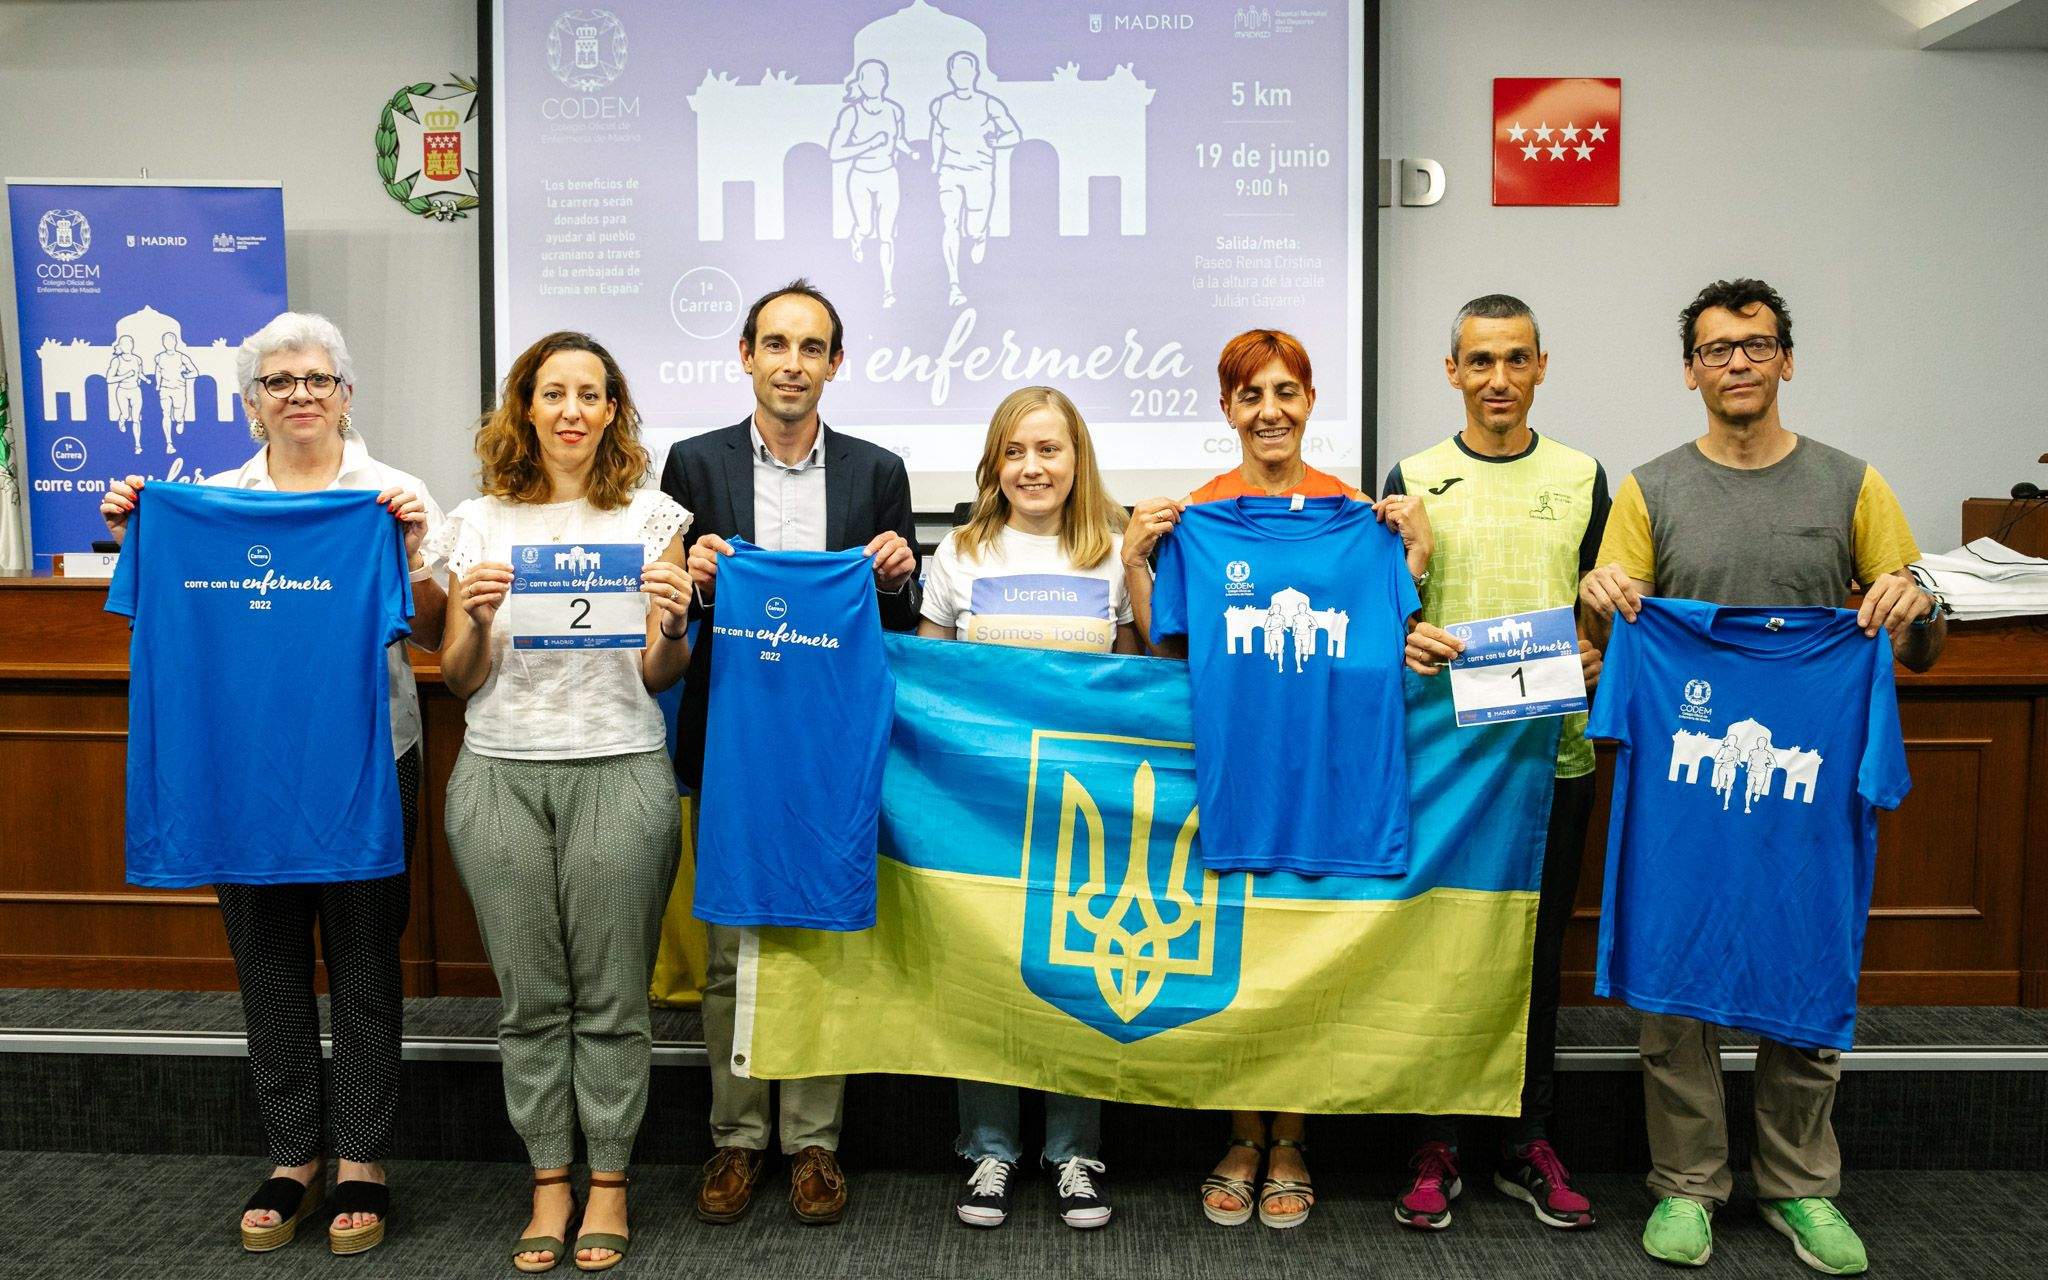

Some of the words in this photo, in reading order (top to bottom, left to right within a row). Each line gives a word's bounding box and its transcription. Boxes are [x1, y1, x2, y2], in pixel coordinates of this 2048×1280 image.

[1115, 15, 1194, 30] MADRID
[1232, 82, 1245, 106] 5
[1255, 81, 1292, 106] km
[542, 97, 640, 119] CODEM
[1195, 143, 1222, 167] 19
[1232, 142, 1260, 167] de
[1268, 143, 1330, 173] junio
[568, 178, 622, 190] beneficios
[626, 178, 640, 189] de
[1235, 179, 1272, 196] 9:00
[1278, 178, 1288, 196] h
[547, 197, 558, 208] la
[560, 199, 599, 208] carrera
[554, 213, 600, 225] donados
[602, 215, 627, 227] para
[141, 236, 187, 246] MADRID
[544, 231, 583, 245] ayudar
[586, 231, 596, 242] al
[600, 230, 636, 244] pueblo
[541, 249, 594, 260] ucraniano
[597, 250, 604, 259] a
[607, 247, 641, 260] través
[1195, 255, 1232, 269] Paseo
[1274, 254, 1322, 268] Cristina
[36, 264, 100, 278] CODEM
[542, 266, 555, 277] de
[559, 266, 568, 277] la
[571, 265, 624, 279] embajada
[627, 265, 640, 276] de
[1262, 274, 1277, 287] de
[1295, 274, 1325, 287] calle
[540, 284, 581, 295] Ucrania
[583, 285, 597, 294] en
[680, 298, 733, 312] Carrera
[660, 359, 740, 384] corre
[865, 308, 1194, 406] enfermera
[1130, 388, 1198, 417] 2022
[55, 451, 82, 459] Carrera
[35, 479, 72, 492] corre
[77, 479, 105, 492] con
[184, 580, 208, 588] corre
[211, 580, 227, 588] con
[230, 580, 239, 588] tu
[242, 569, 333, 596] enfermera
[571, 571, 638, 591] enfermera
[1225, 582, 1254, 590] CODEM
[1003, 588, 1078, 602] Ucrania
[249, 601, 271, 609] 2022
[569, 597, 592, 630] 2
[728, 628, 743, 636] con
[745, 628, 754, 638] tu
[756, 622, 840, 648] enfermera
[976, 626, 1043, 641] Somos
[1051, 627, 1105, 645] Todos
[760, 651, 781, 661] 2022
[1467, 655, 1484, 663] corre
[1507, 640, 1572, 660] enfermera
[1511, 667, 1526, 697] 1
[1679, 704, 1712, 715] CODEM
